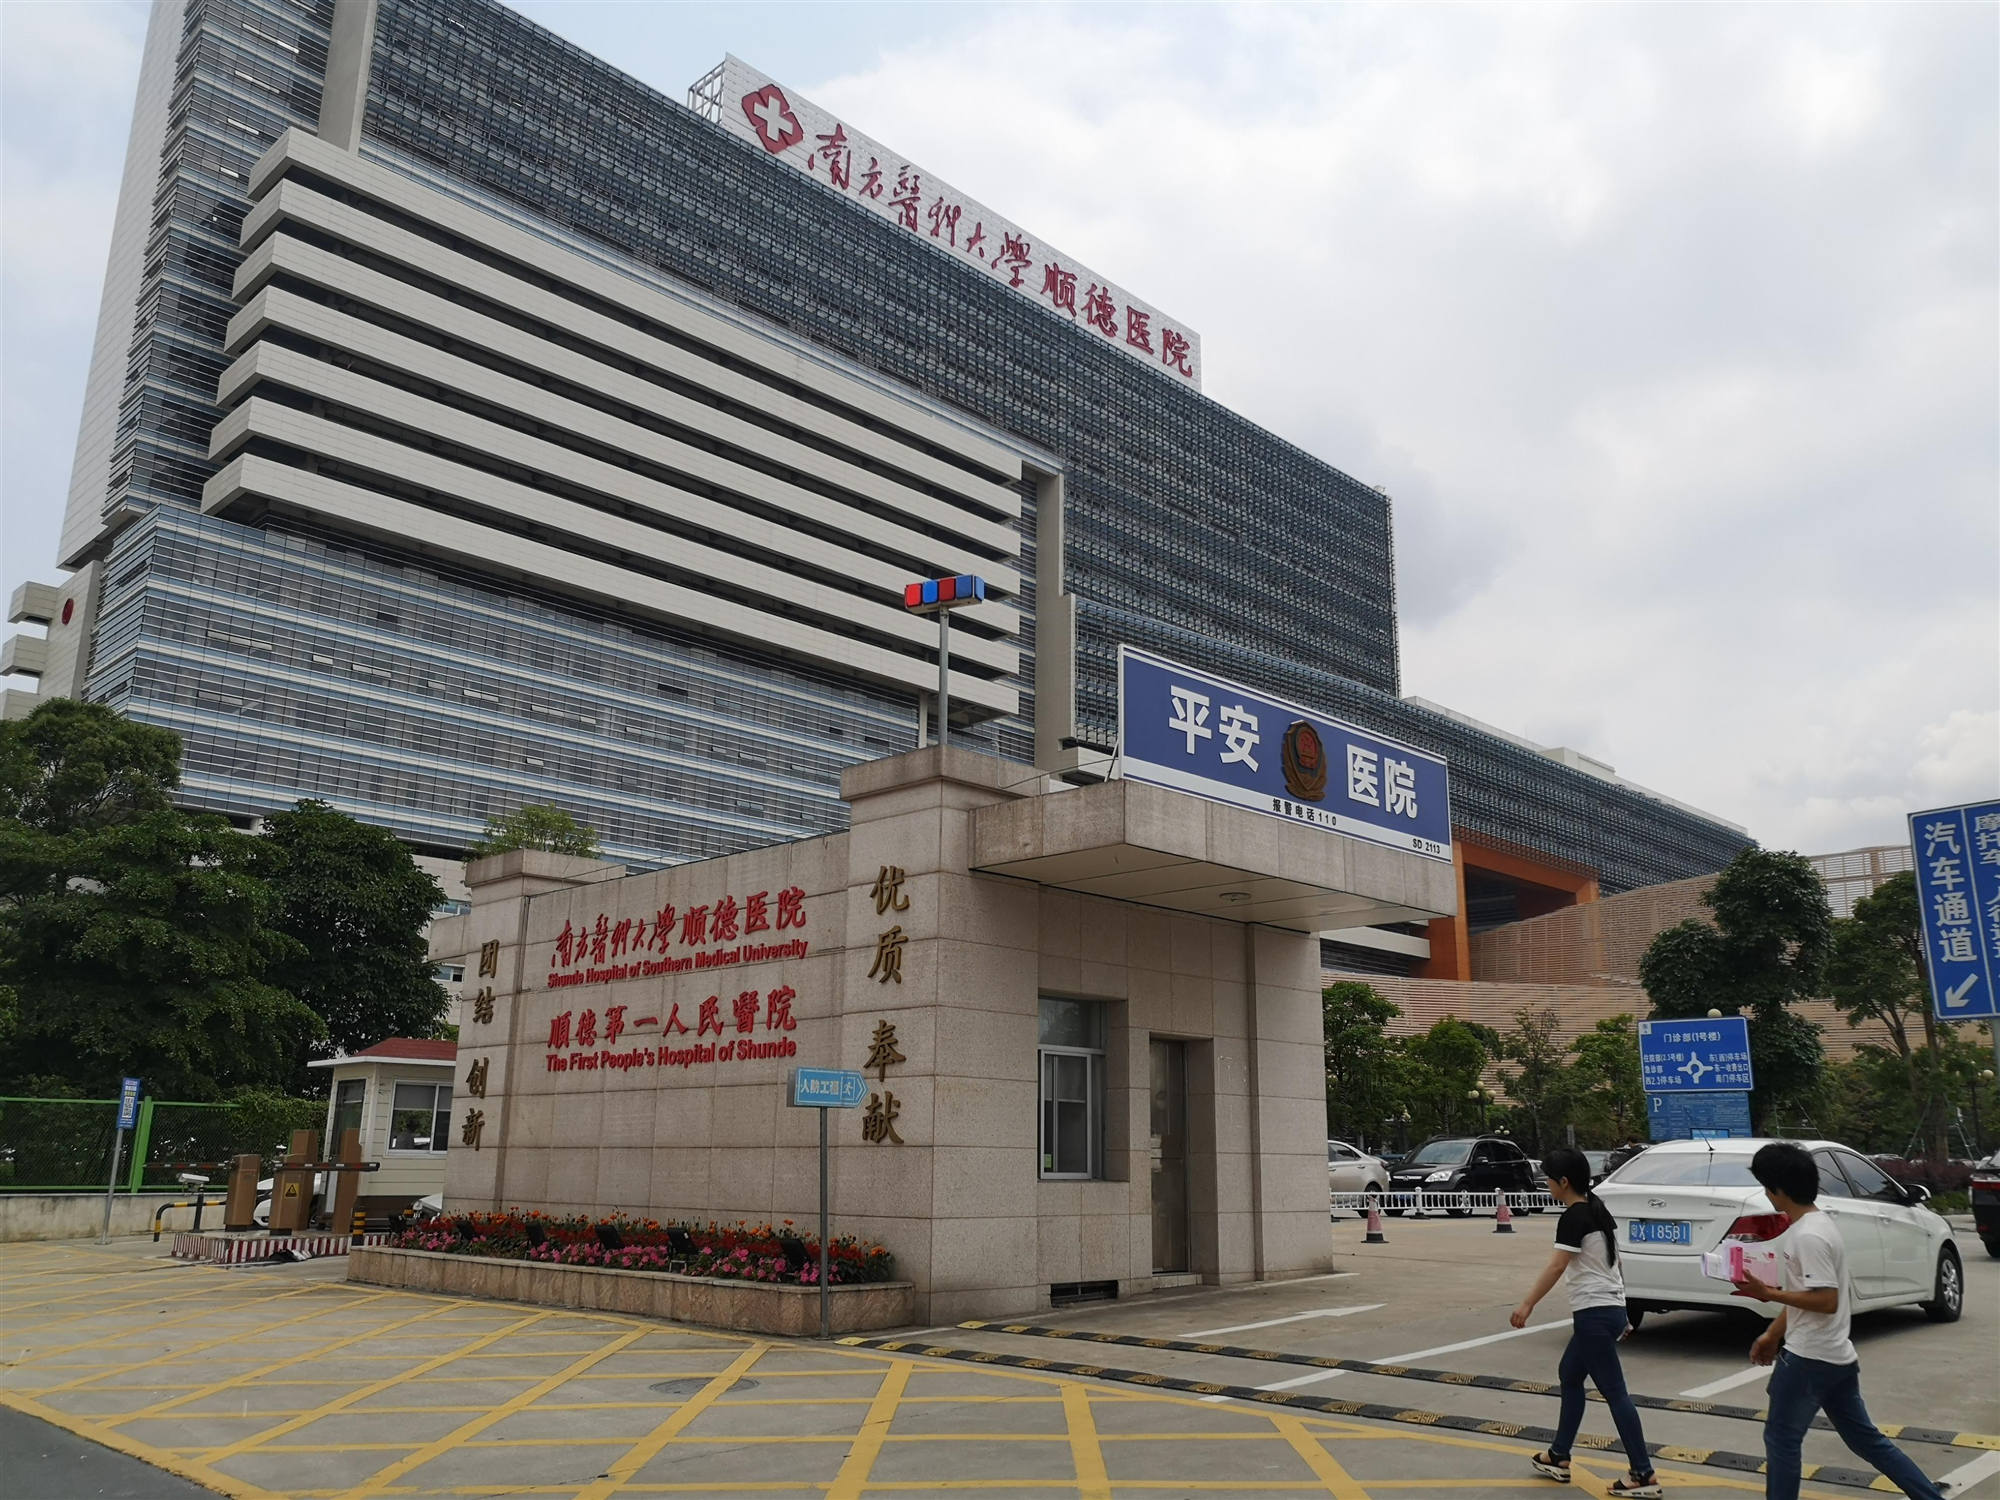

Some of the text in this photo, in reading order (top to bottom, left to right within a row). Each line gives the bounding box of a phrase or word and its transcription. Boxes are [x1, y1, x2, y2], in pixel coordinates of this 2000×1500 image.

[1168, 684, 1418, 819] 平安 医院
[1412, 838, 1441, 855] SD 2113
[1923, 822, 1978, 963] 汽车通道
[548, 939, 809, 988] Shunde Hospital of Southern Medical University
[861, 865, 910, 1146] 优质奉献
[461, 938, 500, 1151] 团结创新
[546, 1037, 797, 1072] The First People's Hospital of Shunde
[1652, 1097, 1663, 1113] P
